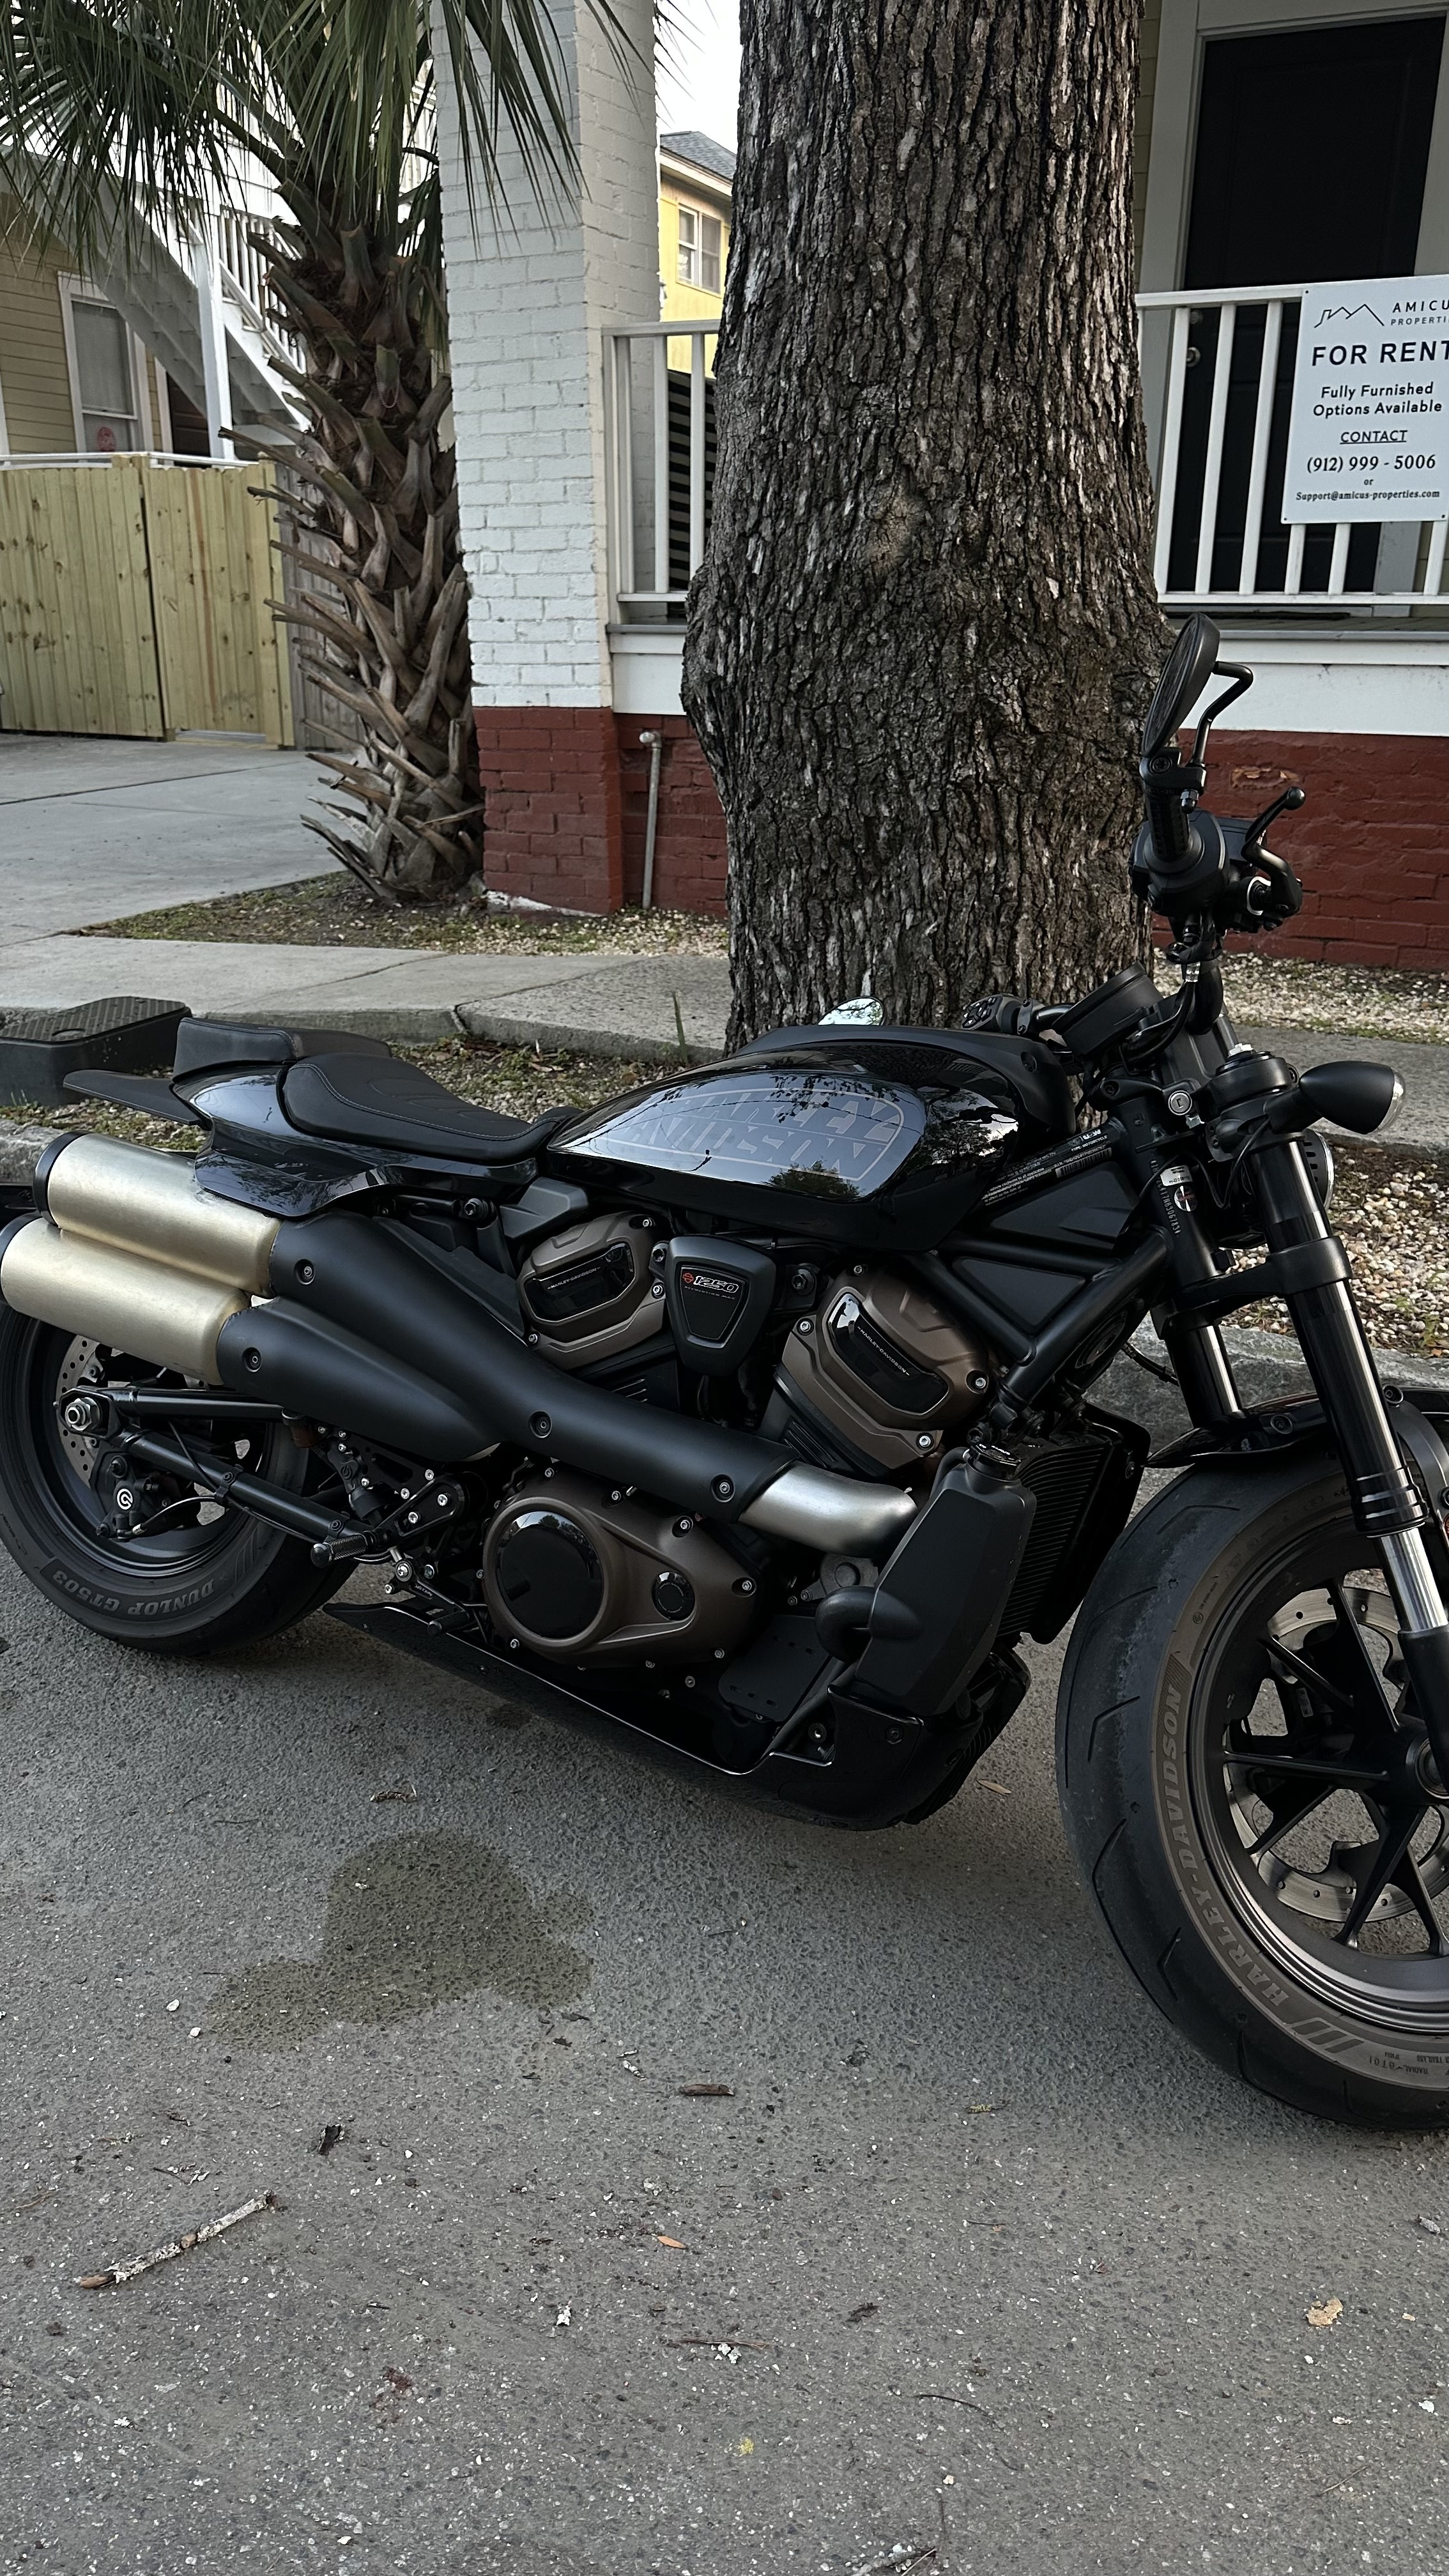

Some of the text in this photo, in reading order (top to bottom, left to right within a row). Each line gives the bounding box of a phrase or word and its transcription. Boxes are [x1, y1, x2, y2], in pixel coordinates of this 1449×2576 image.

[1391, 316, 1449, 325] PROPERTI
[1312, 341, 1449, 366] FOR RENT
[1321, 381, 1434, 401] Fully Furnished
[1313, 399, 1442, 418] Options Available
[1340, 430, 1407, 443] CONTACT
[1307, 456, 1344, 473] (912)
[1349, 456, 1379, 471] 999
[1394, 454, 1436, 470] 5006
[1296, 490, 1440, 502] Support@amicus-properties.com
[693, 1275, 739, 1293] 1250
[52, 1571, 215, 1616] DUNLOP GT503
[1162, 1684, 1290, 2007] HARLEY-DAVIDSON
